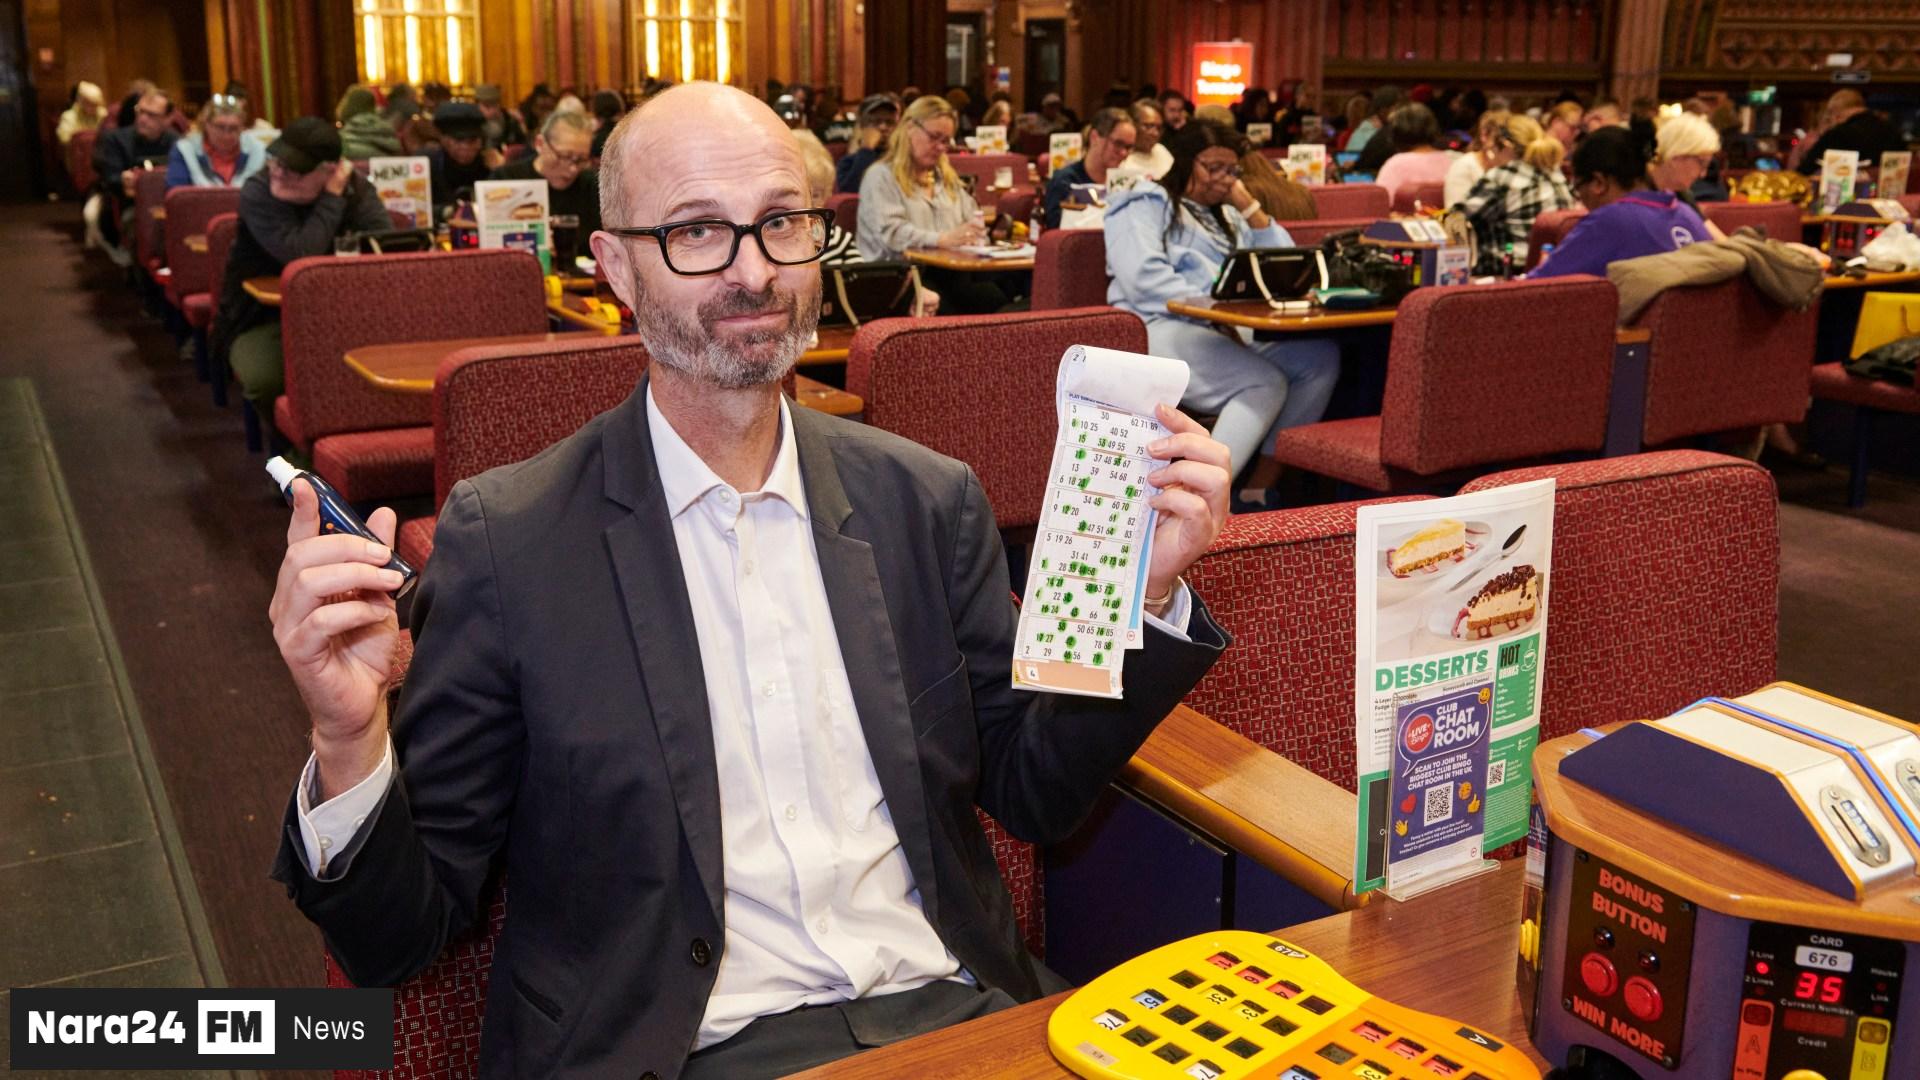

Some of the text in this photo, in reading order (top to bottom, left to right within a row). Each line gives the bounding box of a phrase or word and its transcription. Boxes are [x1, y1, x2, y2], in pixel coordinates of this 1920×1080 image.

[1081, 420, 1089, 429] 10
[1090, 422, 1098, 431] 25
[1110, 427, 1119, 436] 40
[1120, 429, 1128, 438] 52
[1131, 418, 1139, 427] 62
[1141, 420, 1148, 428] 71
[1117, 442, 1126, 451] 55
[1136, 446, 1144, 455] 75
[1094, 454, 1102, 462] 37
[1104, 456, 1112, 464] 48
[1123, 460, 1131, 469] 67
[1069, 477, 1076, 485] 18
[1072, 463, 1145, 484] 13 39 54 68 81
[1083, 496, 1091, 504] 34
[1112, 501, 1120, 510] 60
[1121, 503, 1130, 511] 70
[1071, 507, 1079, 516] 20
[1127, 517, 1136, 526] 82
[1088, 524, 1095, 532] 47
[1097, 525, 1104, 534] 51
[1055, 534, 1063, 544] 19
[1064, 536, 1072, 544] 26
[1093, 541, 1101, 549] 57
[1071, 551, 1079, 559] 31
[1081, 552, 1088, 560] 41
[1100, 555, 1107, 564] 69
[1058, 563, 1066, 571] 28
[1053, 592, 1061, 600] 22
[1090, 611, 1098, 619] 66
[1077, 624, 1085, 633] 50
[1086, 626, 1094, 635] 65
[1105, 628, 1114, 637] 85
[1044, 648, 1052, 657] 29
[1073, 652, 1081, 660] 56
[1500, 644, 1520, 667] HOT
[1376, 649, 1488, 691] DESSERTS
[1436, 702, 1458, 715] CLUB
[1435, 707, 1475, 731] CHAT
[1411, 723, 1428, 737] LIVE
[1434, 721, 1480, 748] ROOM
[1409, 759, 1472, 783] BIGGEST CLUB BINGO
[1414, 764, 1431, 774] SCAN
[1441, 757, 1455, 766] JOIN
[1456, 753, 1468, 761] THE
[1407, 781, 1424, 791] CHAT
[1425, 774, 1444, 786] ROOM
[1452, 769, 1464, 777] THE
[1464, 765, 1472, 774] UK
[1599, 868, 1664, 914] BONUS
[1592, 892, 1667, 944] BUTTON
[1810, 934, 1844, 947] CARD
[1755, 951, 1775, 960] Line
[1808, 952, 1838, 967] 676
[1752, 976, 1774, 986] Lines
[1795, 972, 1843, 1003] 35
[1780, 998, 1855, 1016] Current Number
[1573, 995, 1665, 1060] WIN MORE
[1797, 1036, 1827, 1048] Credit
